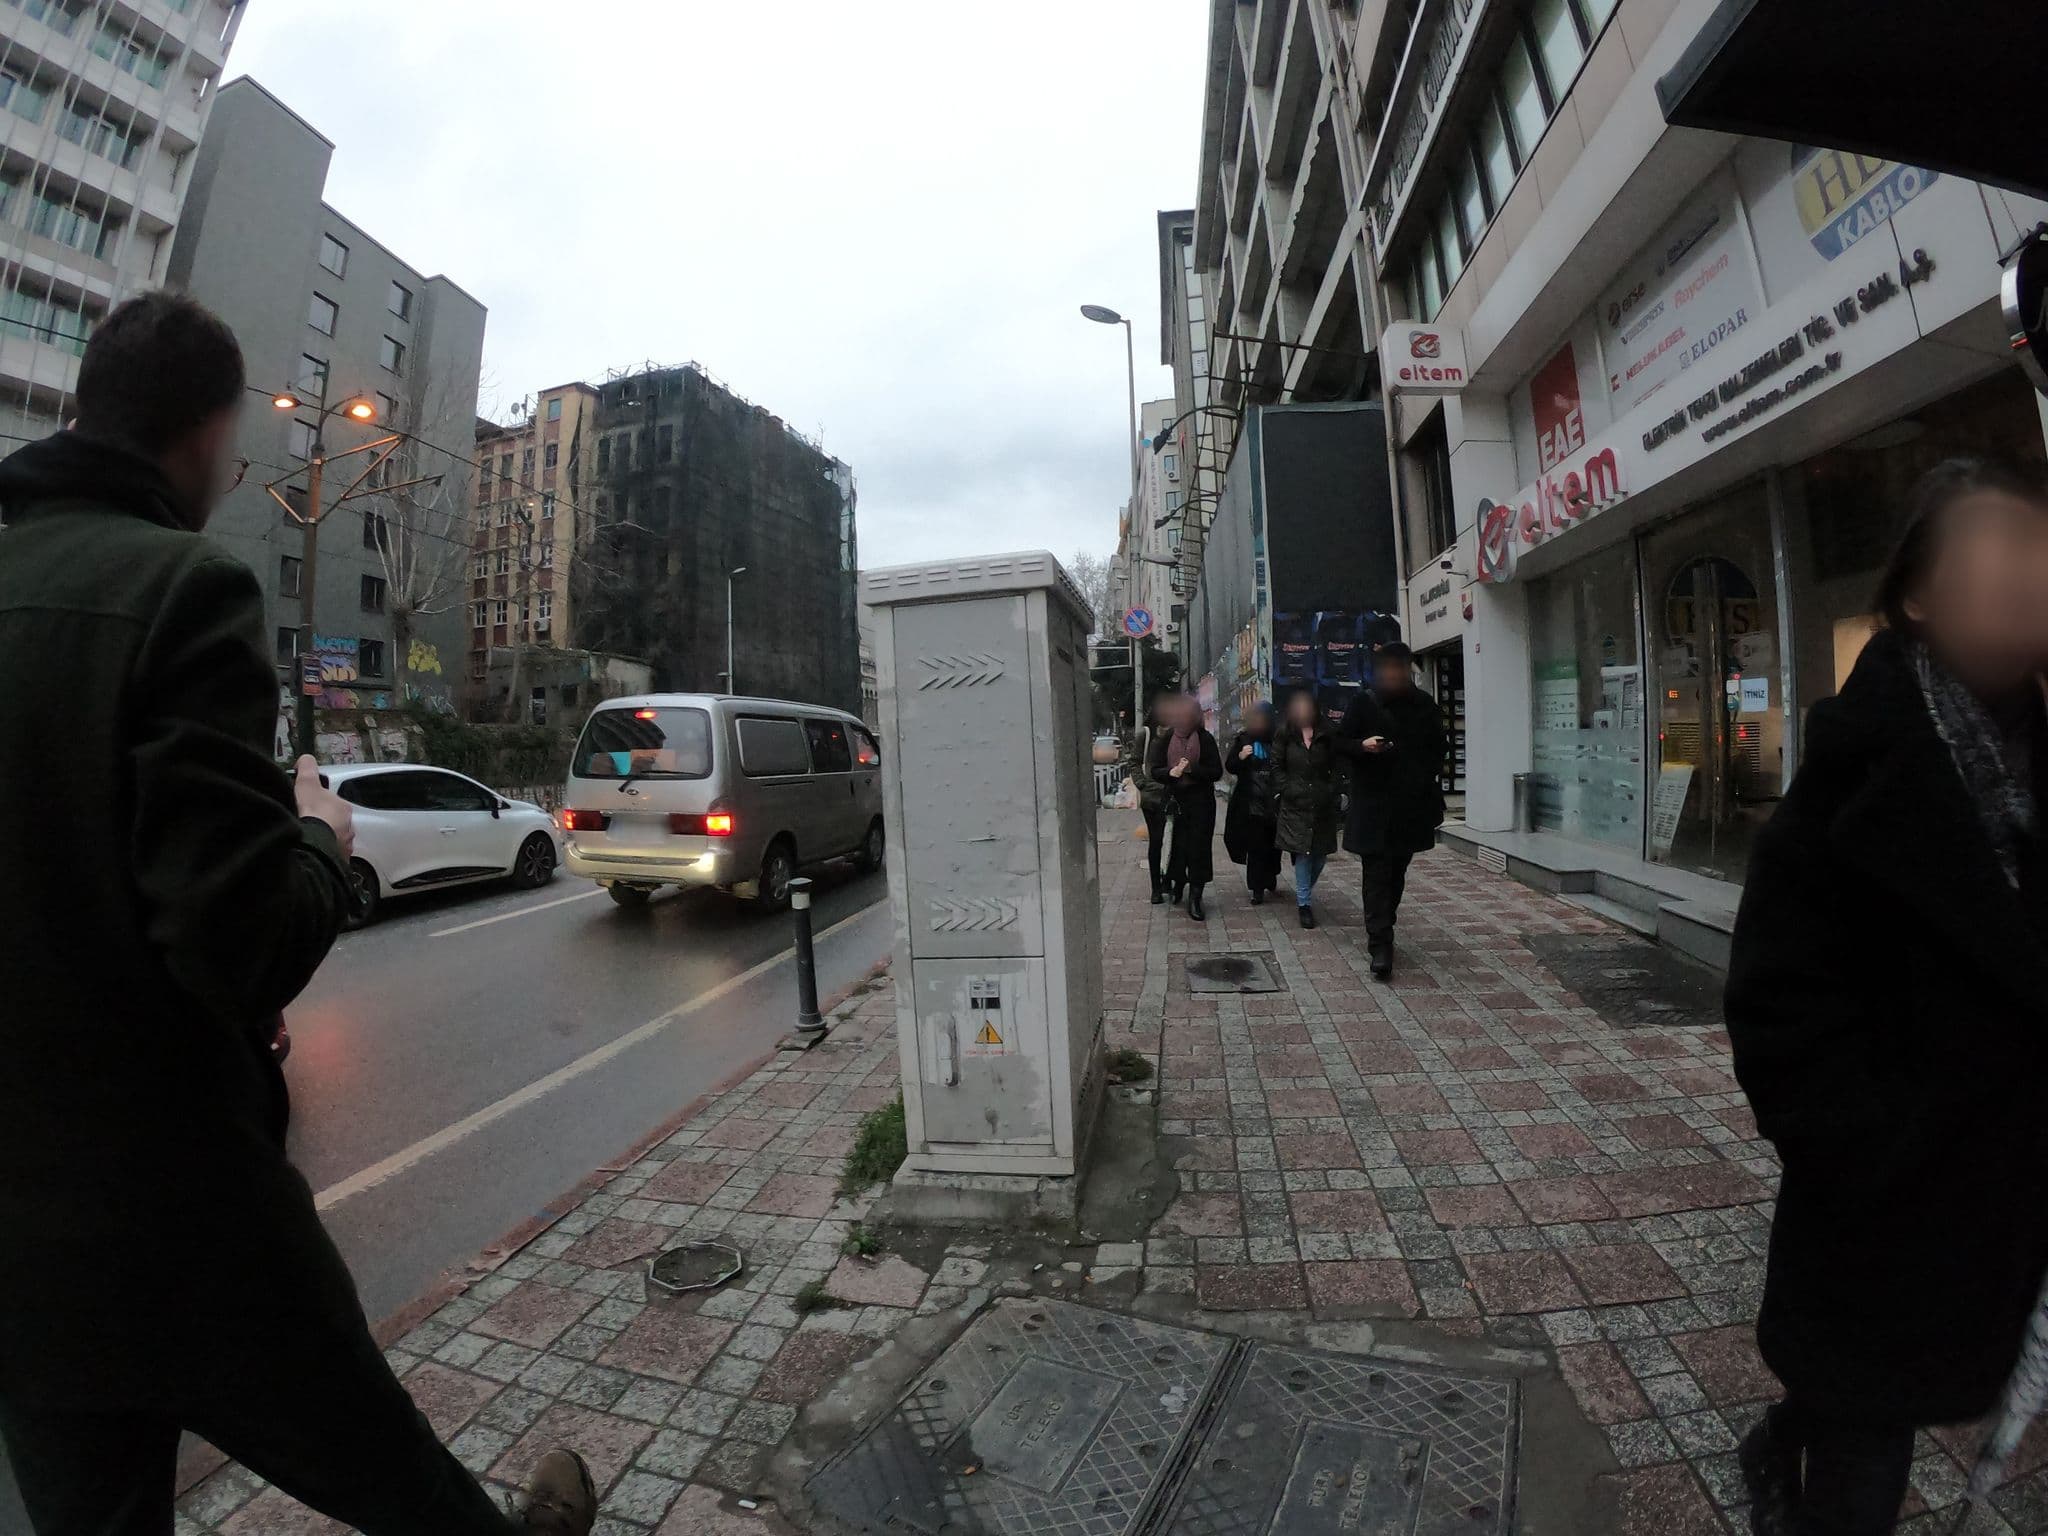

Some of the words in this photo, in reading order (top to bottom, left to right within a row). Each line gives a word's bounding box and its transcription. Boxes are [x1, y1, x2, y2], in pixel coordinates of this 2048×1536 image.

[1837, 166, 1921, 250] KABLO
[1690, 308, 1748, 361] ELOPAR
[1399, 364, 1462, 381] eltem
[1540, 408, 1584, 469] EAE
[1519, 447, 1622, 543] eltem
